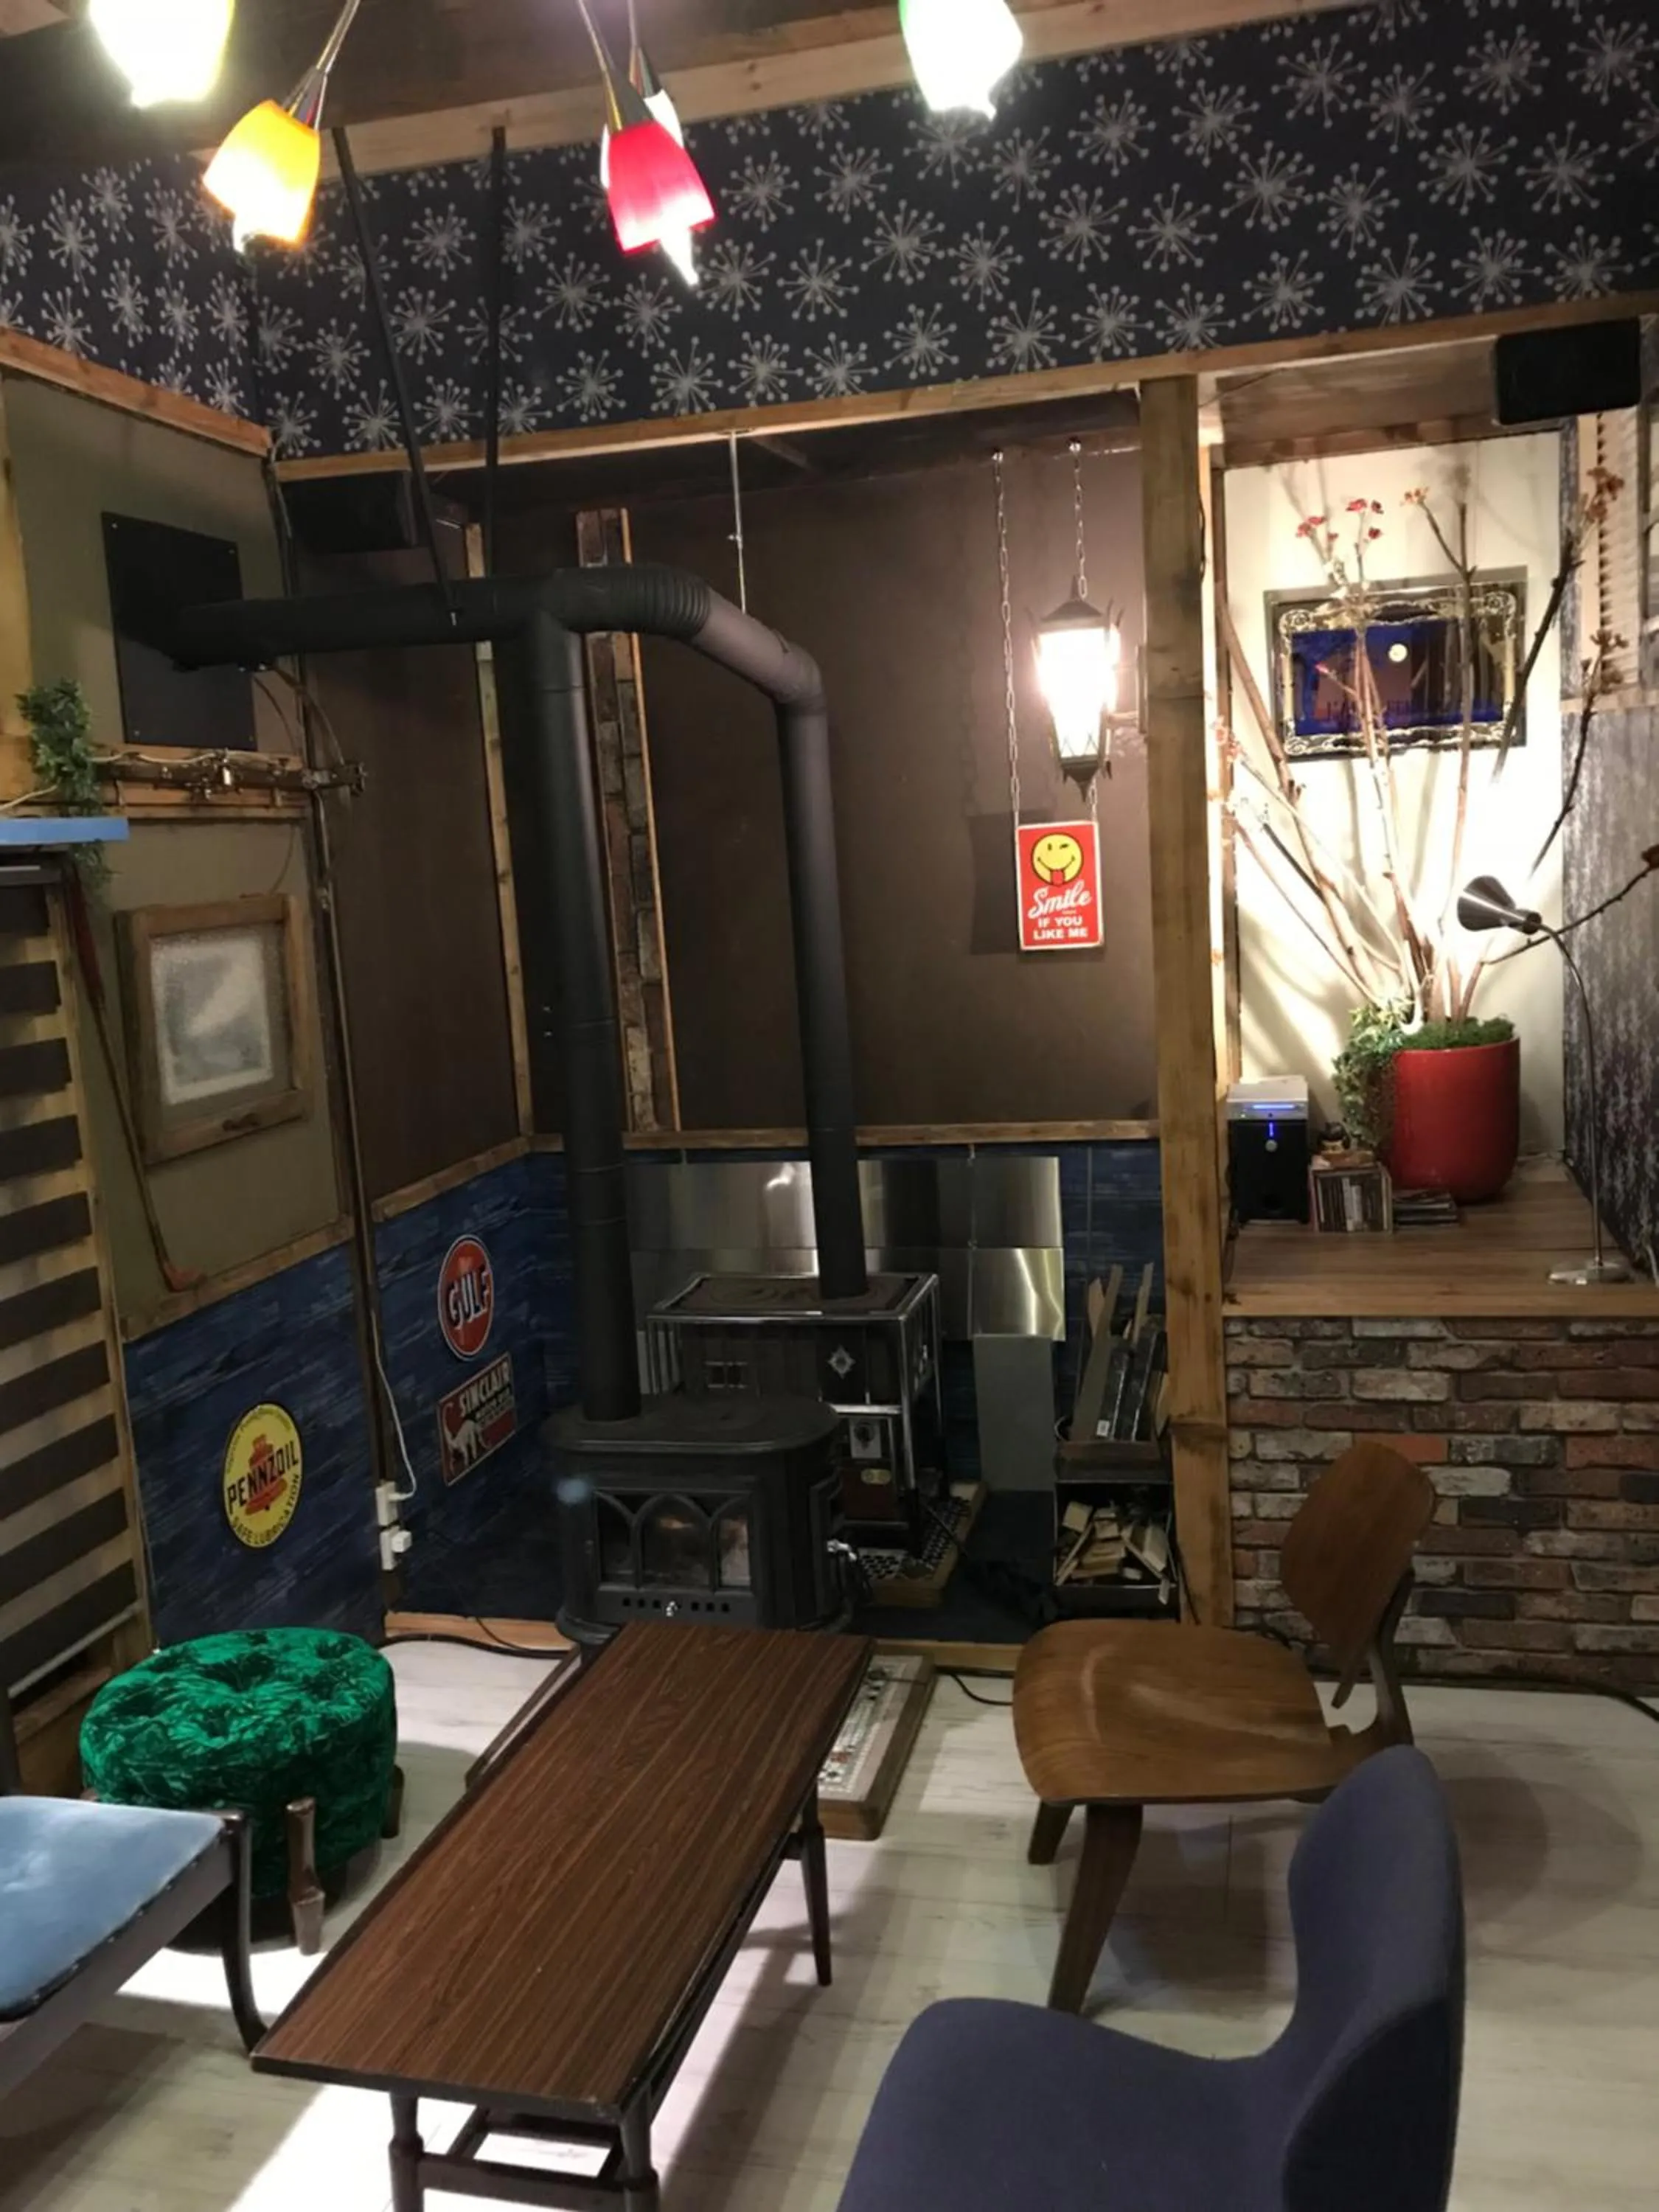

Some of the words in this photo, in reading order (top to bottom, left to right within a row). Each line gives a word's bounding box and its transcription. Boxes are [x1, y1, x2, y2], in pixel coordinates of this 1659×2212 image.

[1028, 880, 1093, 919] Smile
[1038, 918, 1051, 928] IF
[1055, 916, 1083, 927] YOU
[1034, 929, 1065, 940] LIKE
[1069, 928, 1088, 937] ME
[448, 1270, 489, 1330] GULF
[459, 1360, 510, 1418] SINCLAIR
[227, 1440, 299, 1515] PENNZOIL
